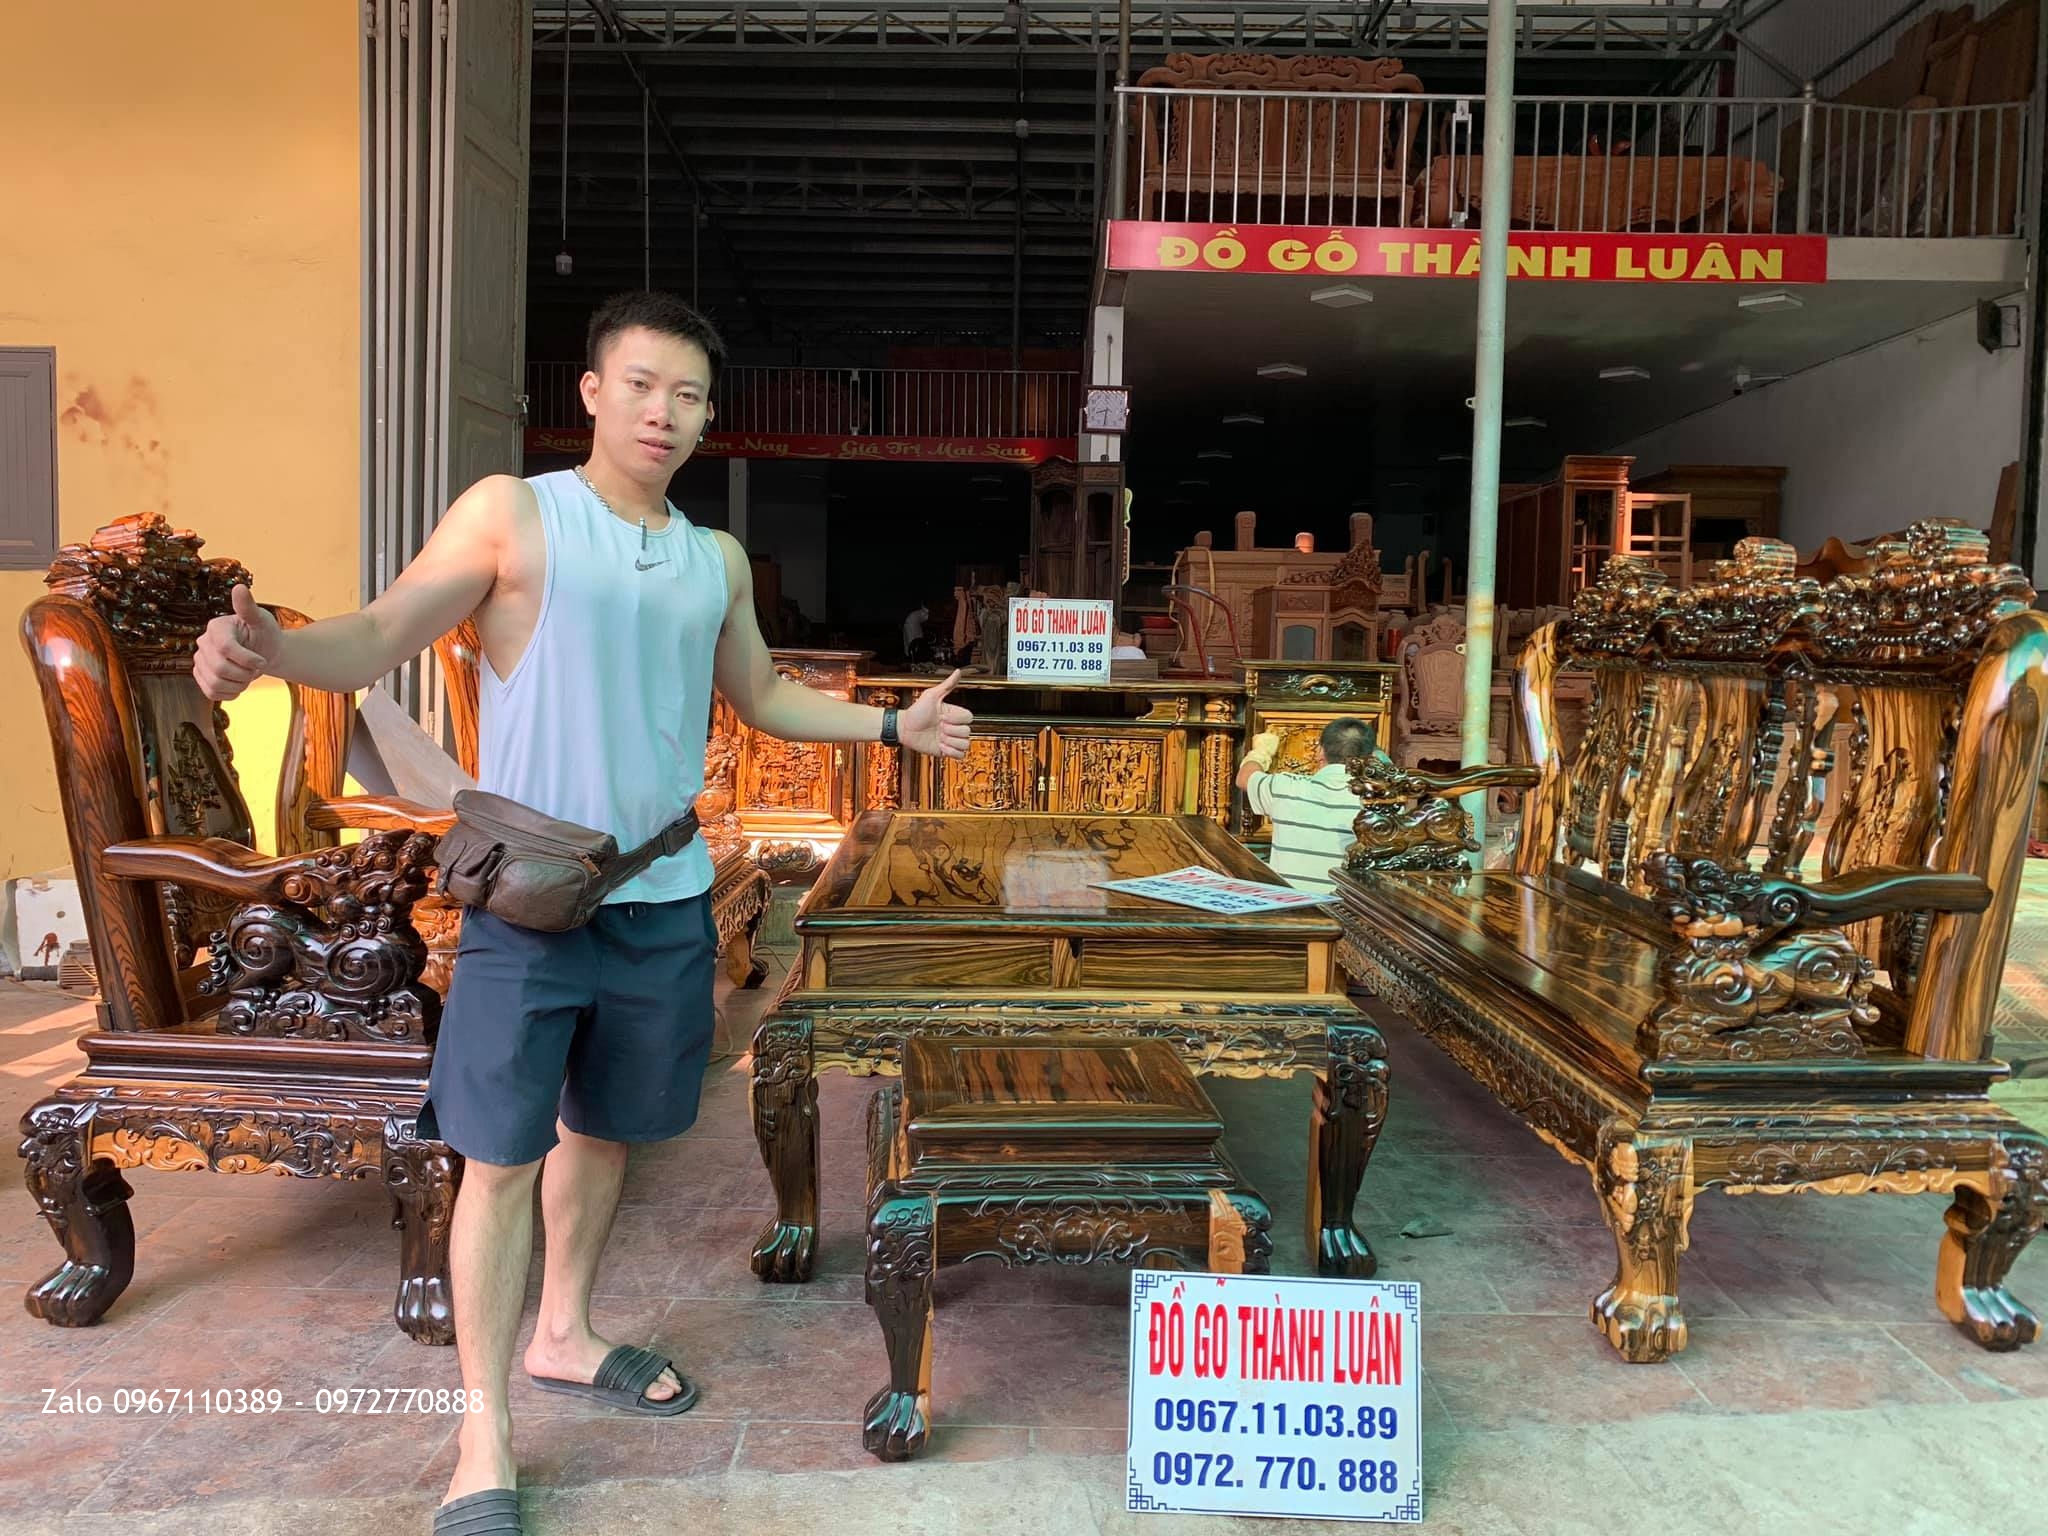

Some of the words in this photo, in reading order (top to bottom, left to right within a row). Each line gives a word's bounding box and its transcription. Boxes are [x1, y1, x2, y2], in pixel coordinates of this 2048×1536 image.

[1156, 227, 1247, 270] ĐỒ
[1267, 229, 1359, 273] GỖ
[1615, 241, 1784, 280] LUÂN
[928, 442, 977, 458] Mai
[981, 443, 1036, 462] Sau
[1047, 604, 1079, 635] THÀNH
[1081, 604, 1107, 636] LUÂN
[1081, 659, 1102, 671] 888
[1149, 1281, 1186, 1378] ĐỒ
[1238, 1293, 1325, 1383] THÀNH
[1333, 1295, 1402, 1386] LUÂN
[1154, 1397, 1398, 1440] 0967.11.03.89
[1338, 1458, 1399, 1494] 888
